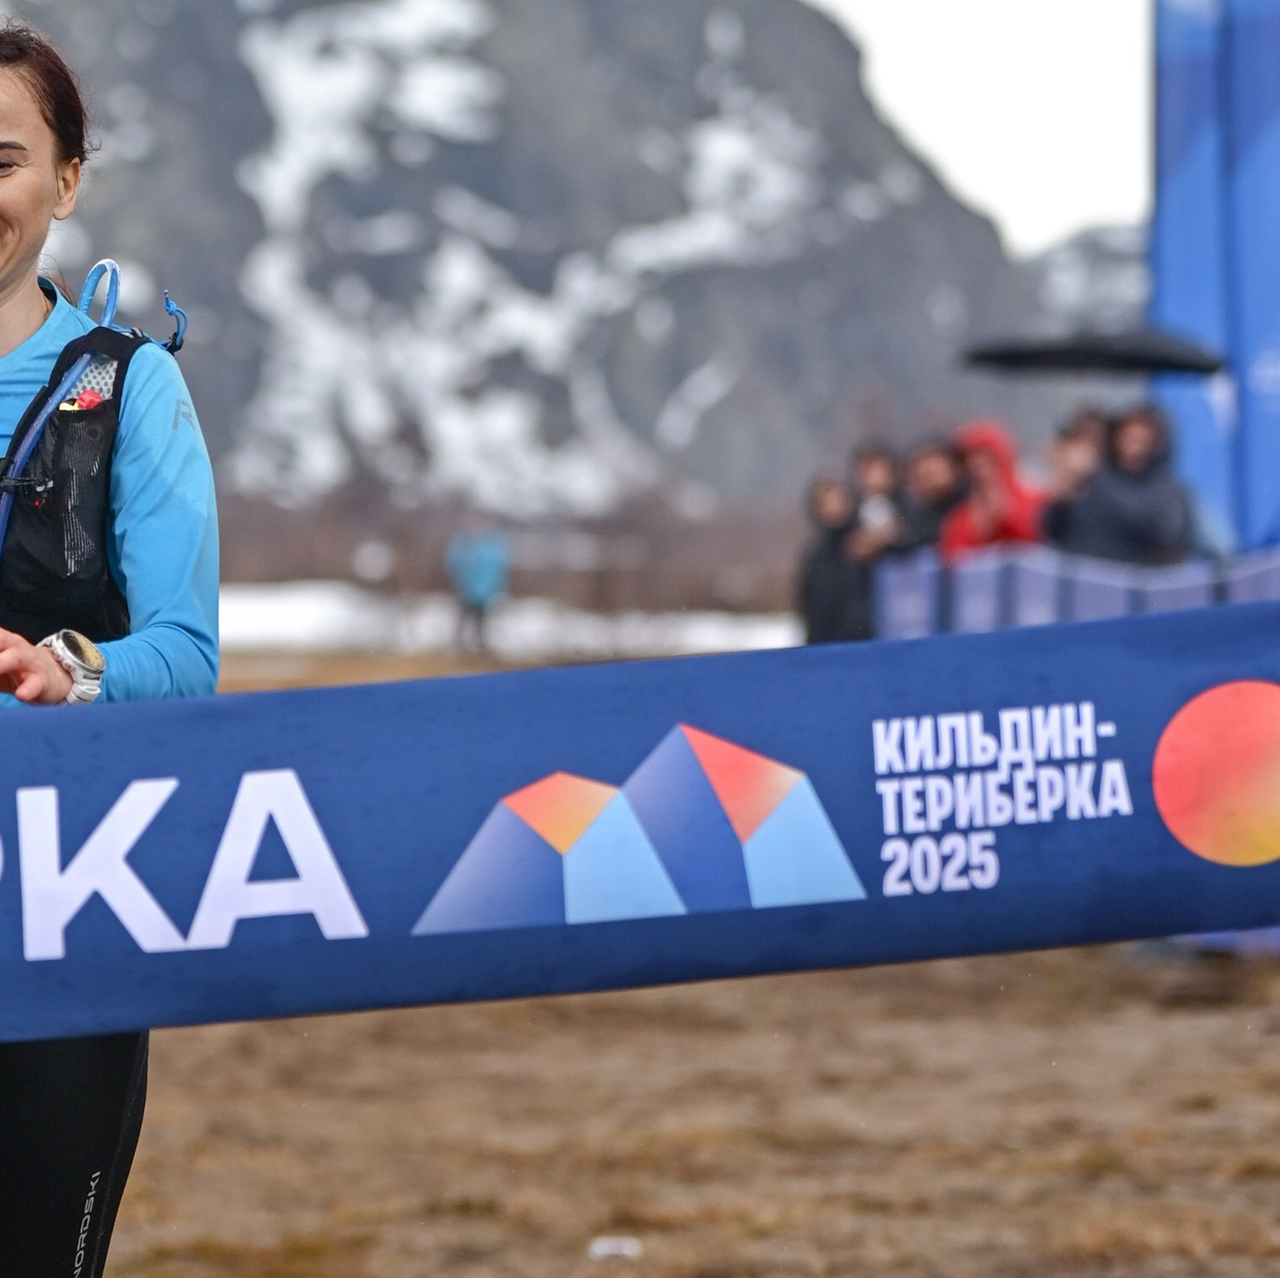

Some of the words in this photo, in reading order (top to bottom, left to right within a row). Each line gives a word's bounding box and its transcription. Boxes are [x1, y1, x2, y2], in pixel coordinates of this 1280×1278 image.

[871, 701, 1117, 783] КИЛЬДИН-
[876, 759, 1134, 835] ТЕРИБЕРКА
[880, 831, 1000, 897] 2025
